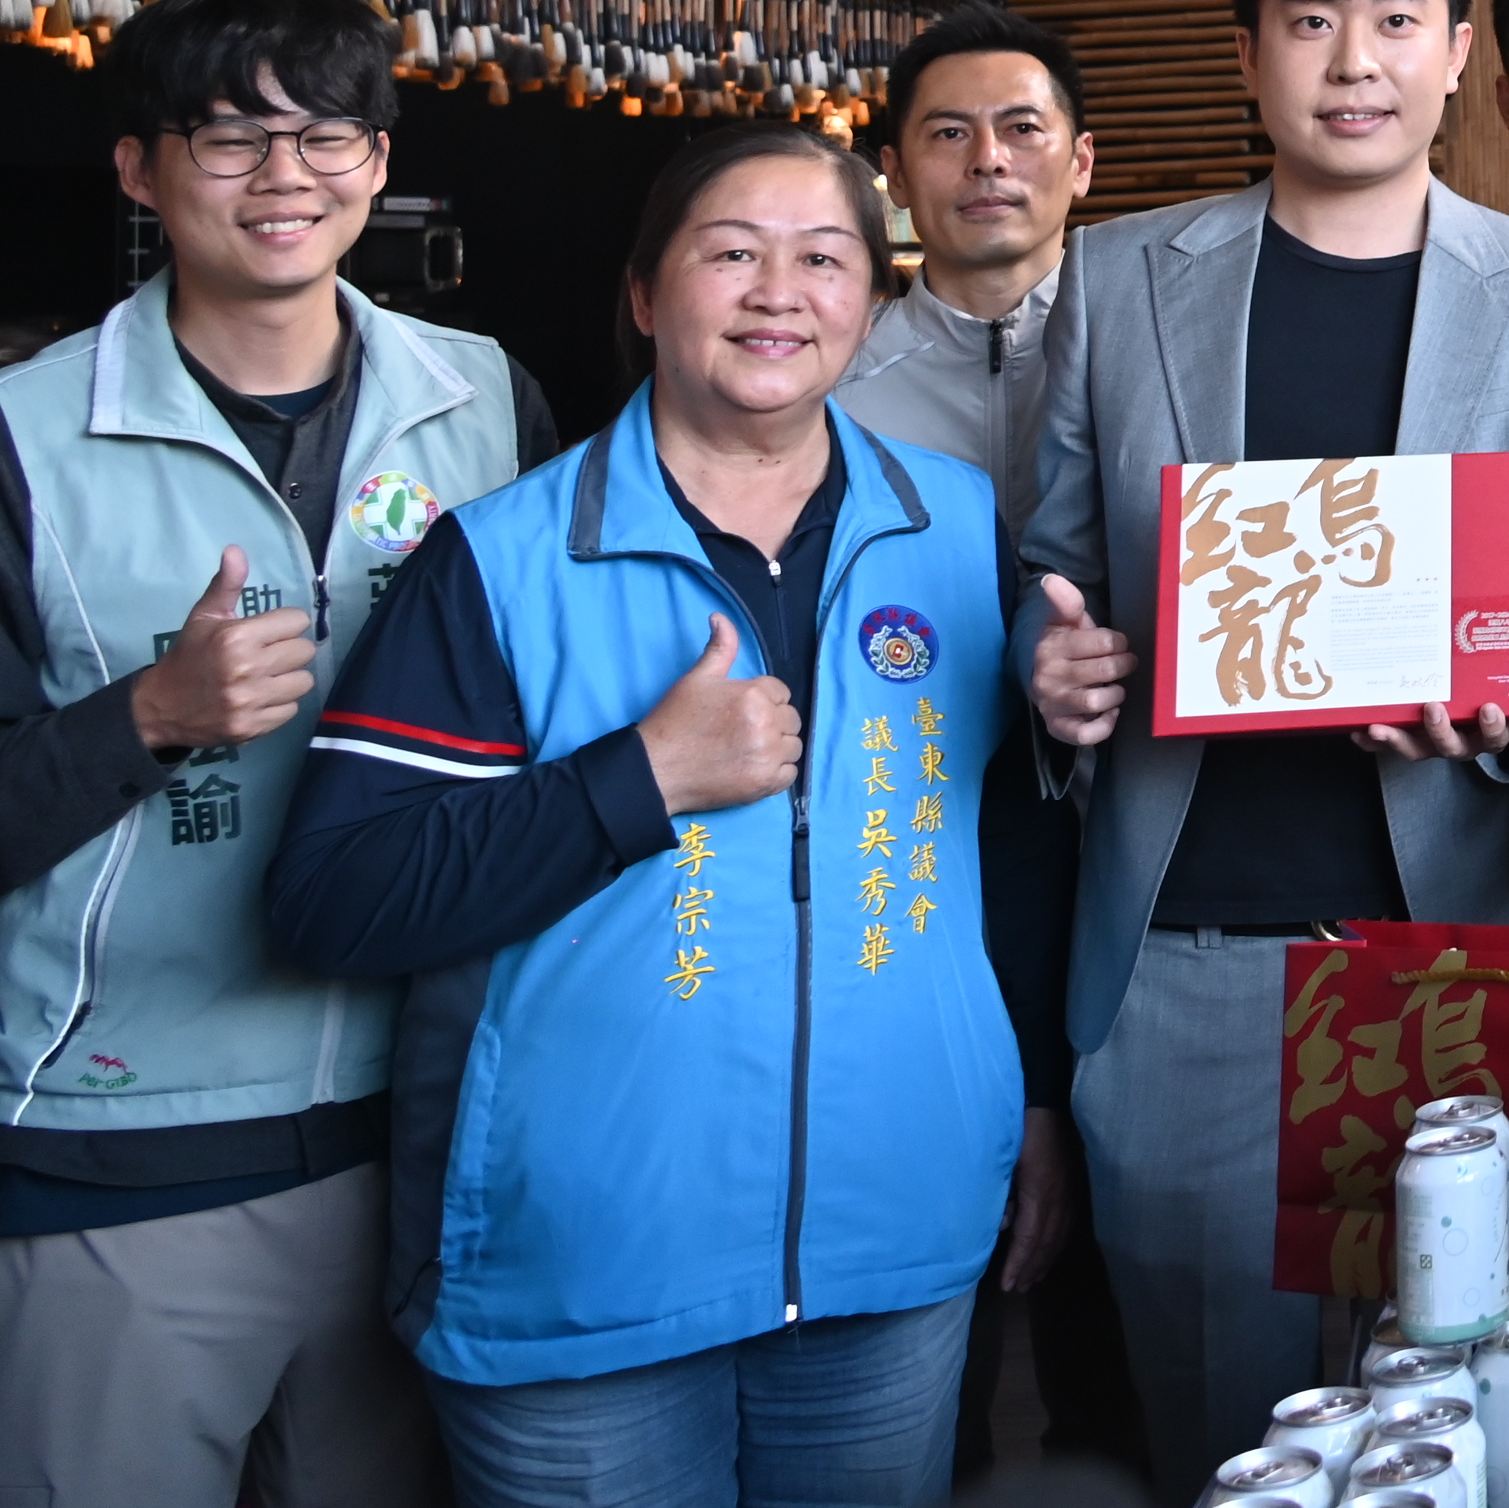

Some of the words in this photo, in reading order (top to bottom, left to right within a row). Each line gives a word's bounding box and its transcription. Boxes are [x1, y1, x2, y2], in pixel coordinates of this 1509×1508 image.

[664, 822, 716, 1000] 李宗芳
[855, 716, 899, 976] 議長吳秀華
[905, 697, 949, 934] 臺東縣議會
